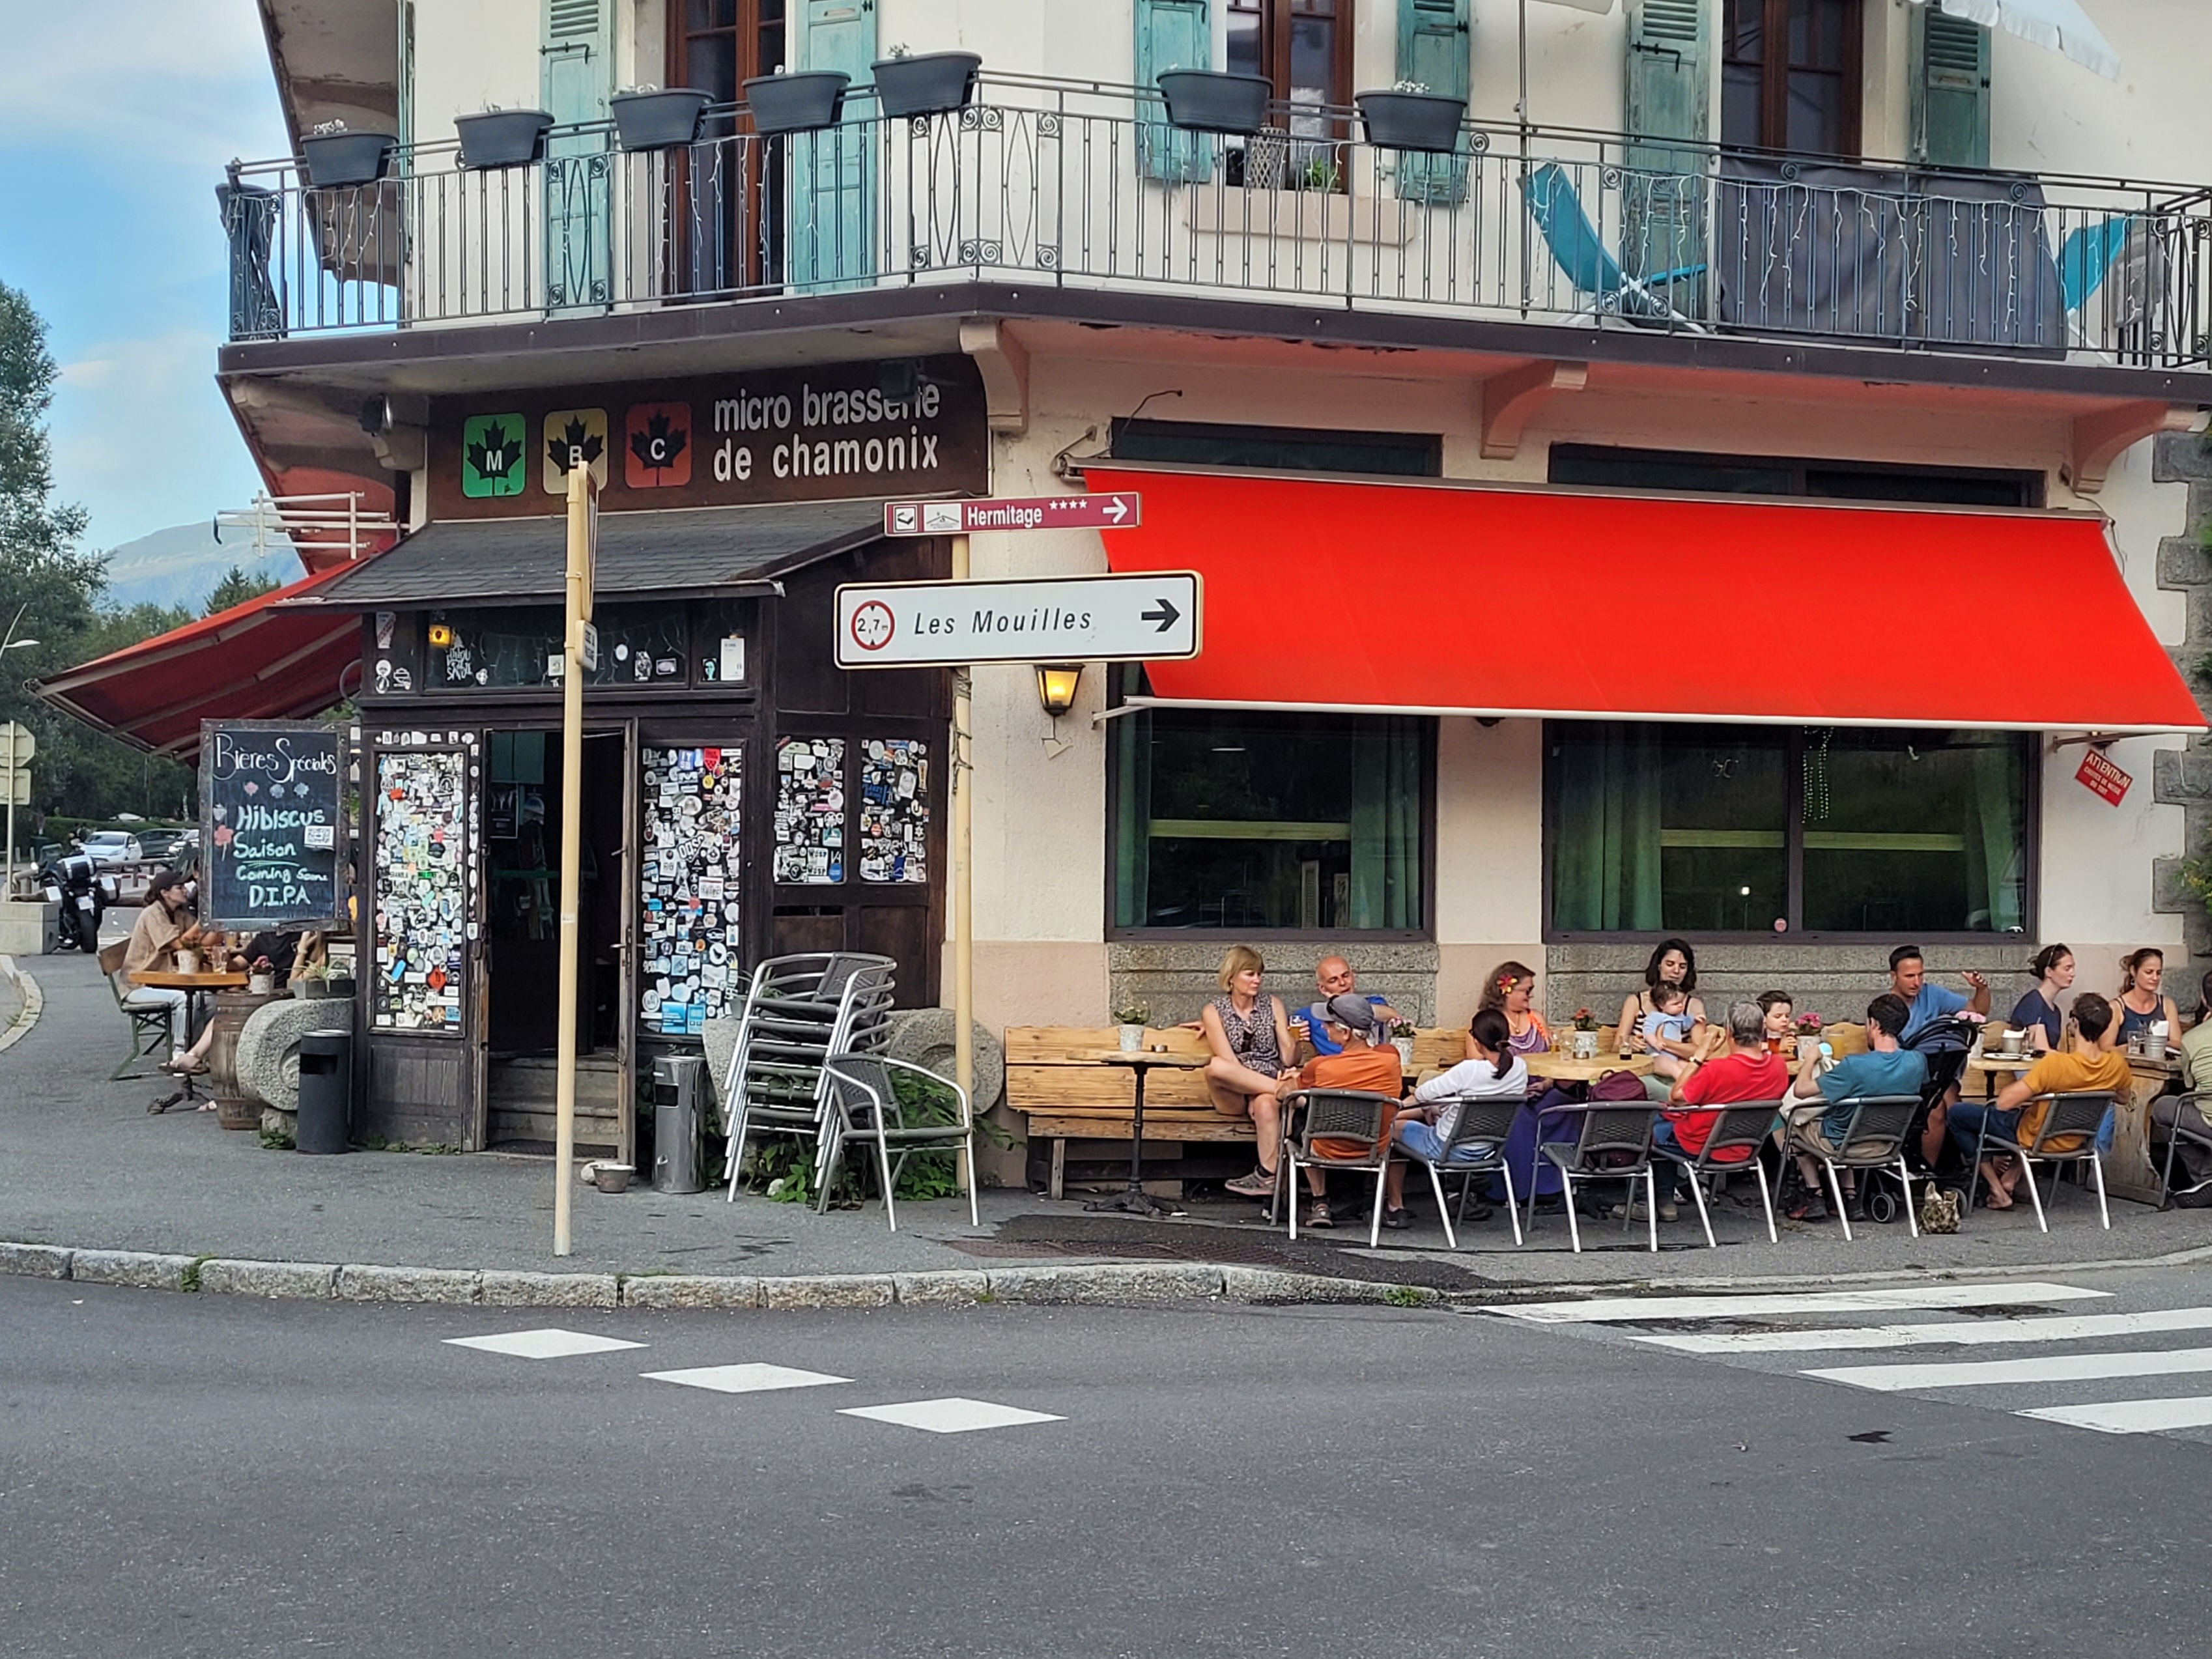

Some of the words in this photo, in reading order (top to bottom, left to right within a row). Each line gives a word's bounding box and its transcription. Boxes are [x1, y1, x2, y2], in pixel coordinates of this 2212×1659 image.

[715, 388, 791, 432] micro
[486, 449, 502, 472] M
[569, 446, 583, 466] B
[651, 439, 665, 460] C
[714, 438, 752, 481] de
[773, 425, 937, 478] chamonix
[967, 505, 1042, 528] Hermitage
[915, 613, 955, 634] Les
[972, 608, 1091, 633] Mouilles
[213, 733, 279, 780] Bières
[233, 831, 296, 858] Saison
